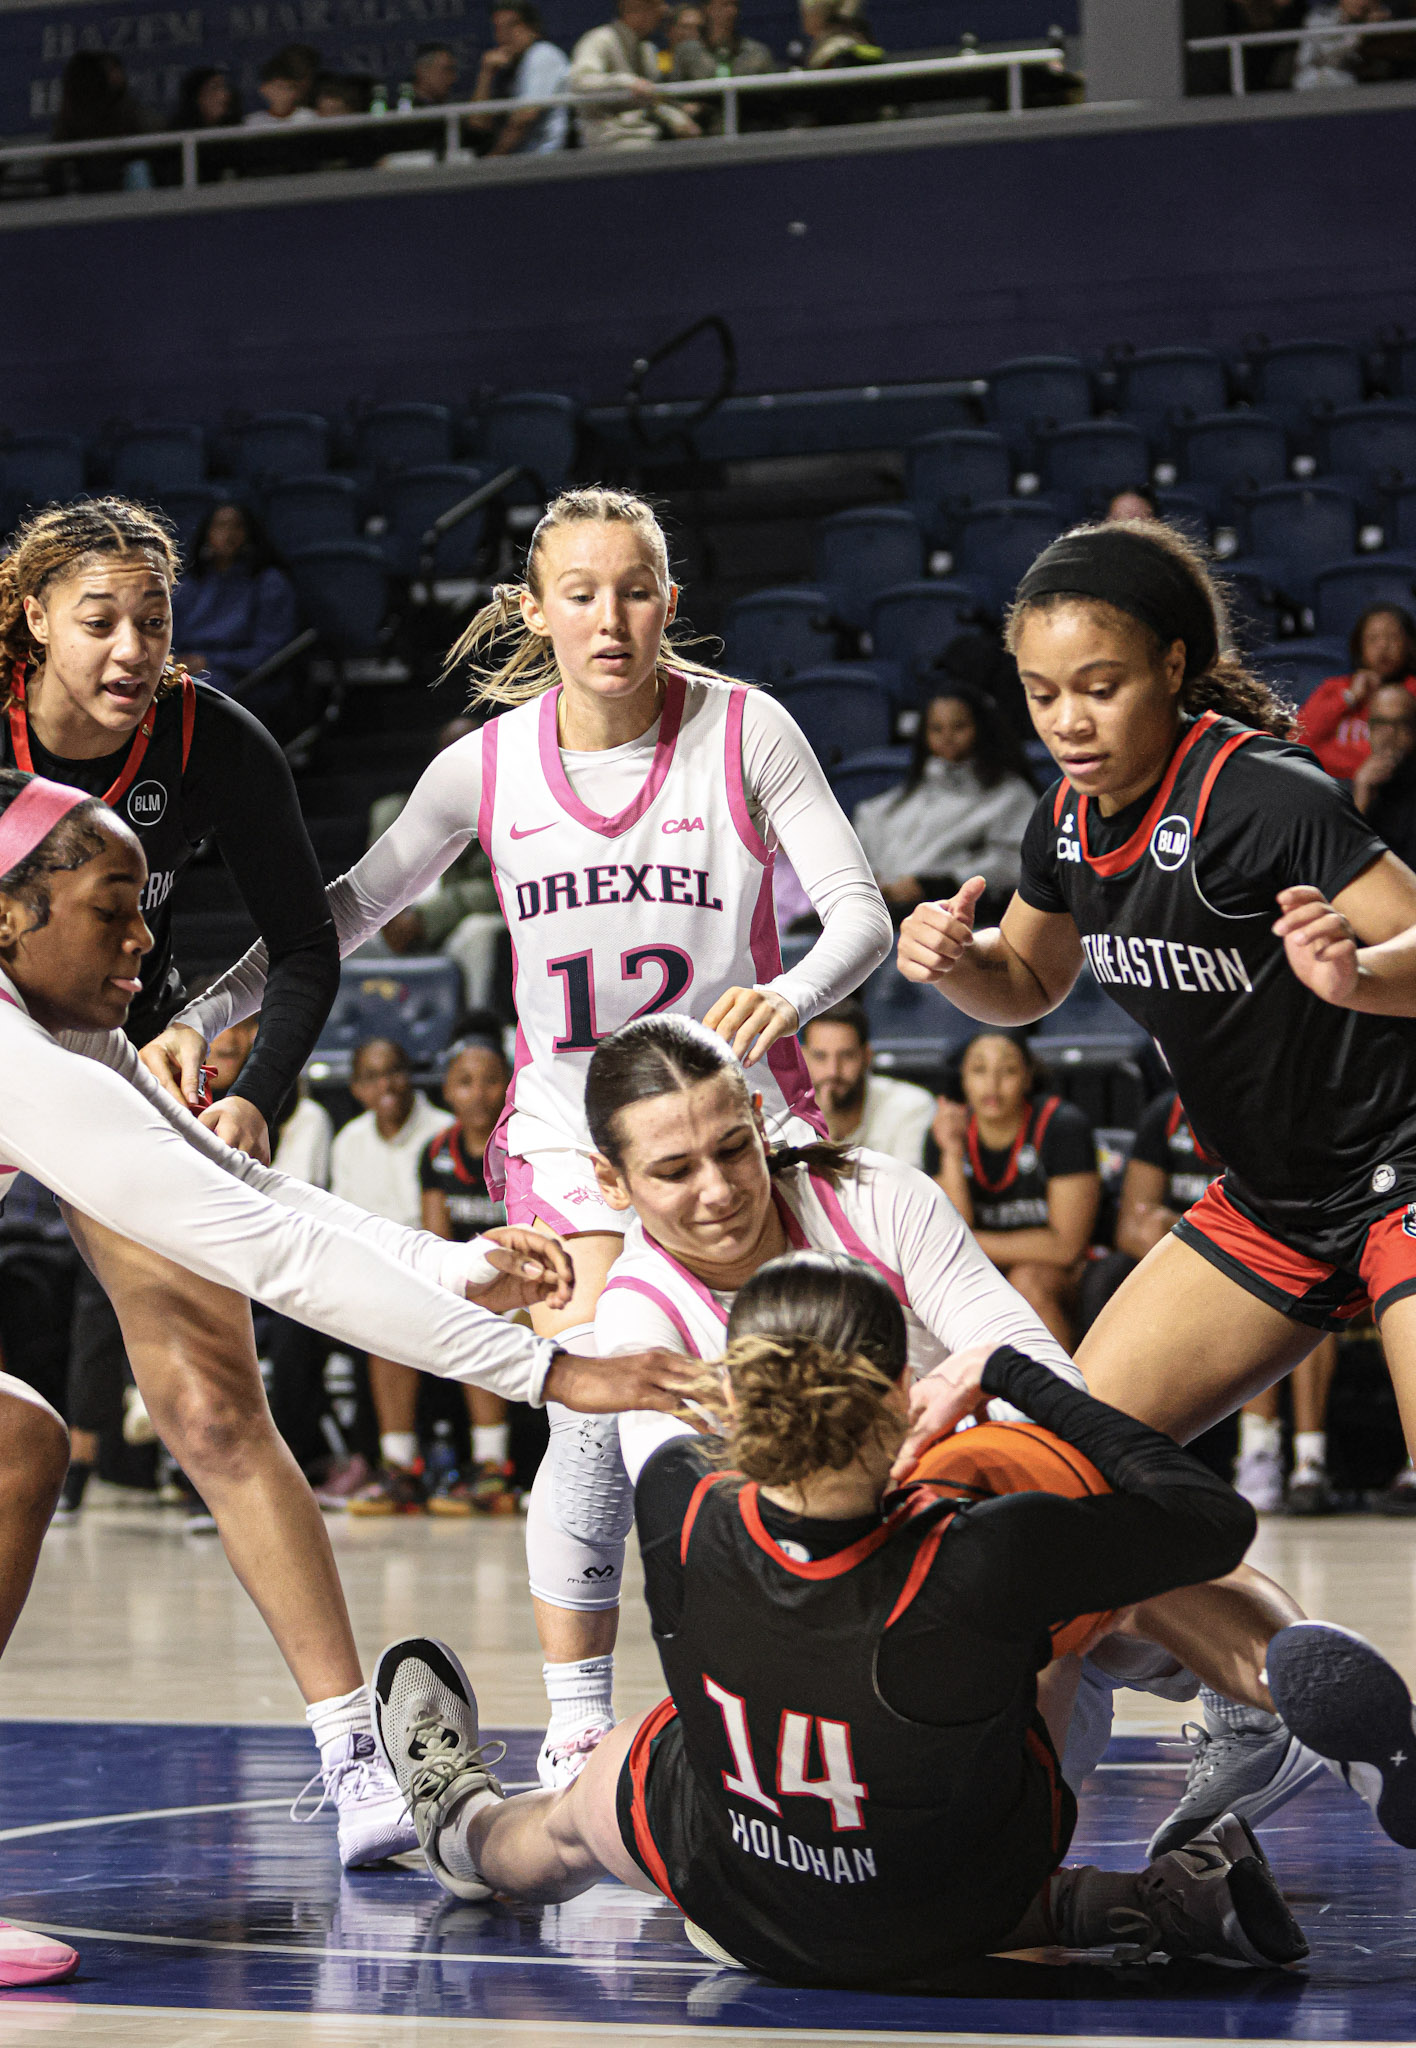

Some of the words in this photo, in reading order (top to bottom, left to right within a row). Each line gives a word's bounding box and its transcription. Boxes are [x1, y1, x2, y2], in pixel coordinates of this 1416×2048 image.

[134, 793, 161, 812] BLM
[661, 817, 705, 834] CAA
[1157, 829, 1186, 855] BLM
[515, 863, 724, 922] DREXEL
[1081, 933, 1254, 993] THEASTERN
[546, 942, 695, 1054] 12
[702, 1672, 870, 1833] 14
[727, 1807, 878, 1885] HOLOHAN
